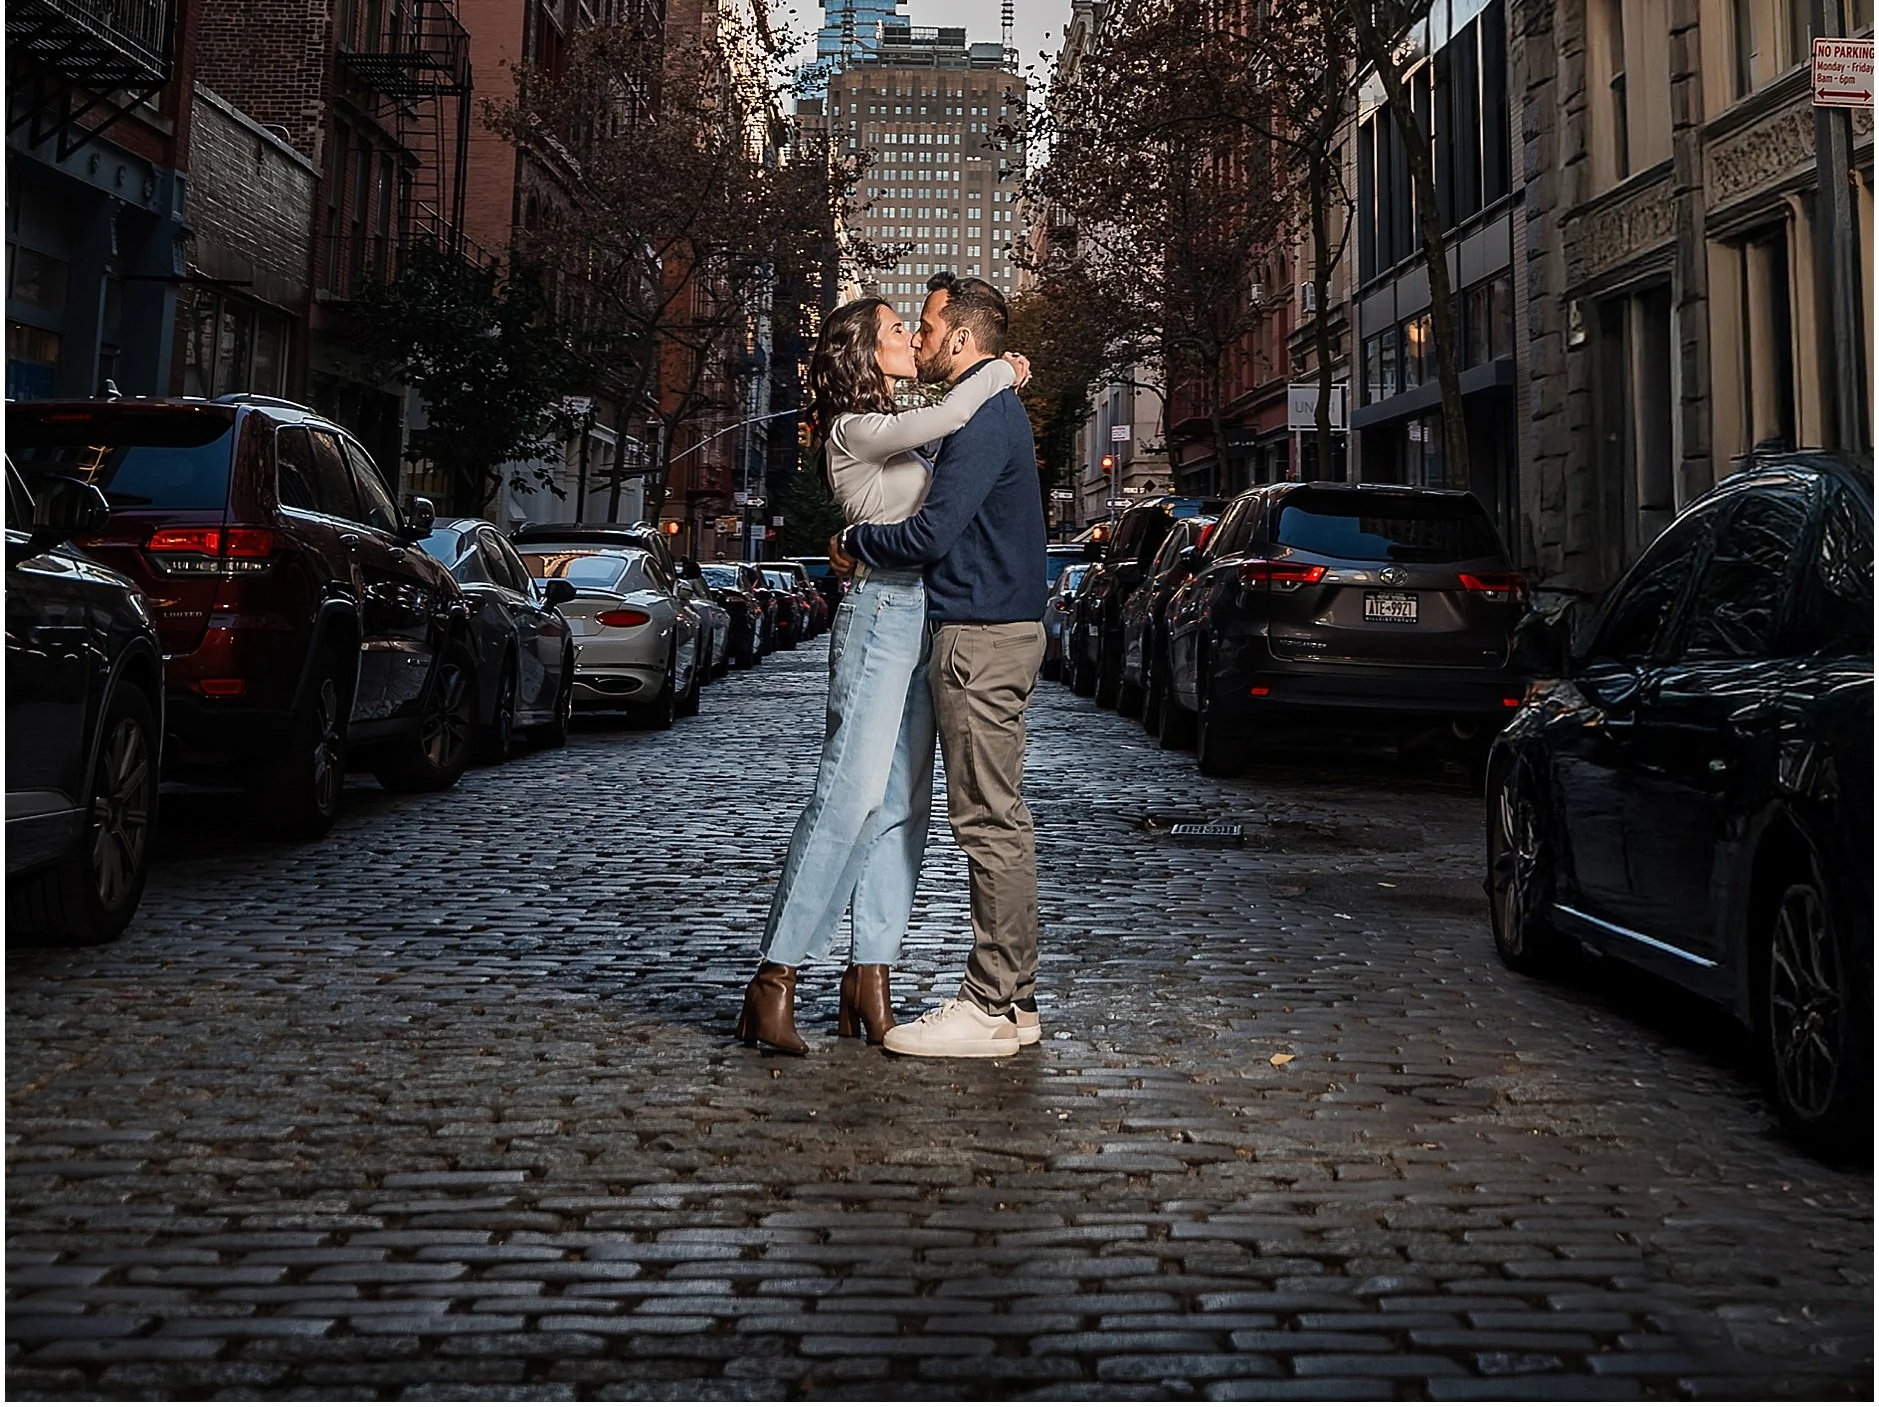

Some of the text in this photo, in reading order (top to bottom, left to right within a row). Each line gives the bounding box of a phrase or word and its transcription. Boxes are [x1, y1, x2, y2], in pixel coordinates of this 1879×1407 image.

[1818, 46, 1874, 59] NO PARKING
[1817, 61, 1845, 73] Monday
[1852, 62, 1874, 75] Friday
[1817, 73, 1832, 83] 8am
[1840, 74, 1855, 85] 6pm
[1369, 600, 1411, 615] ATE 9921
